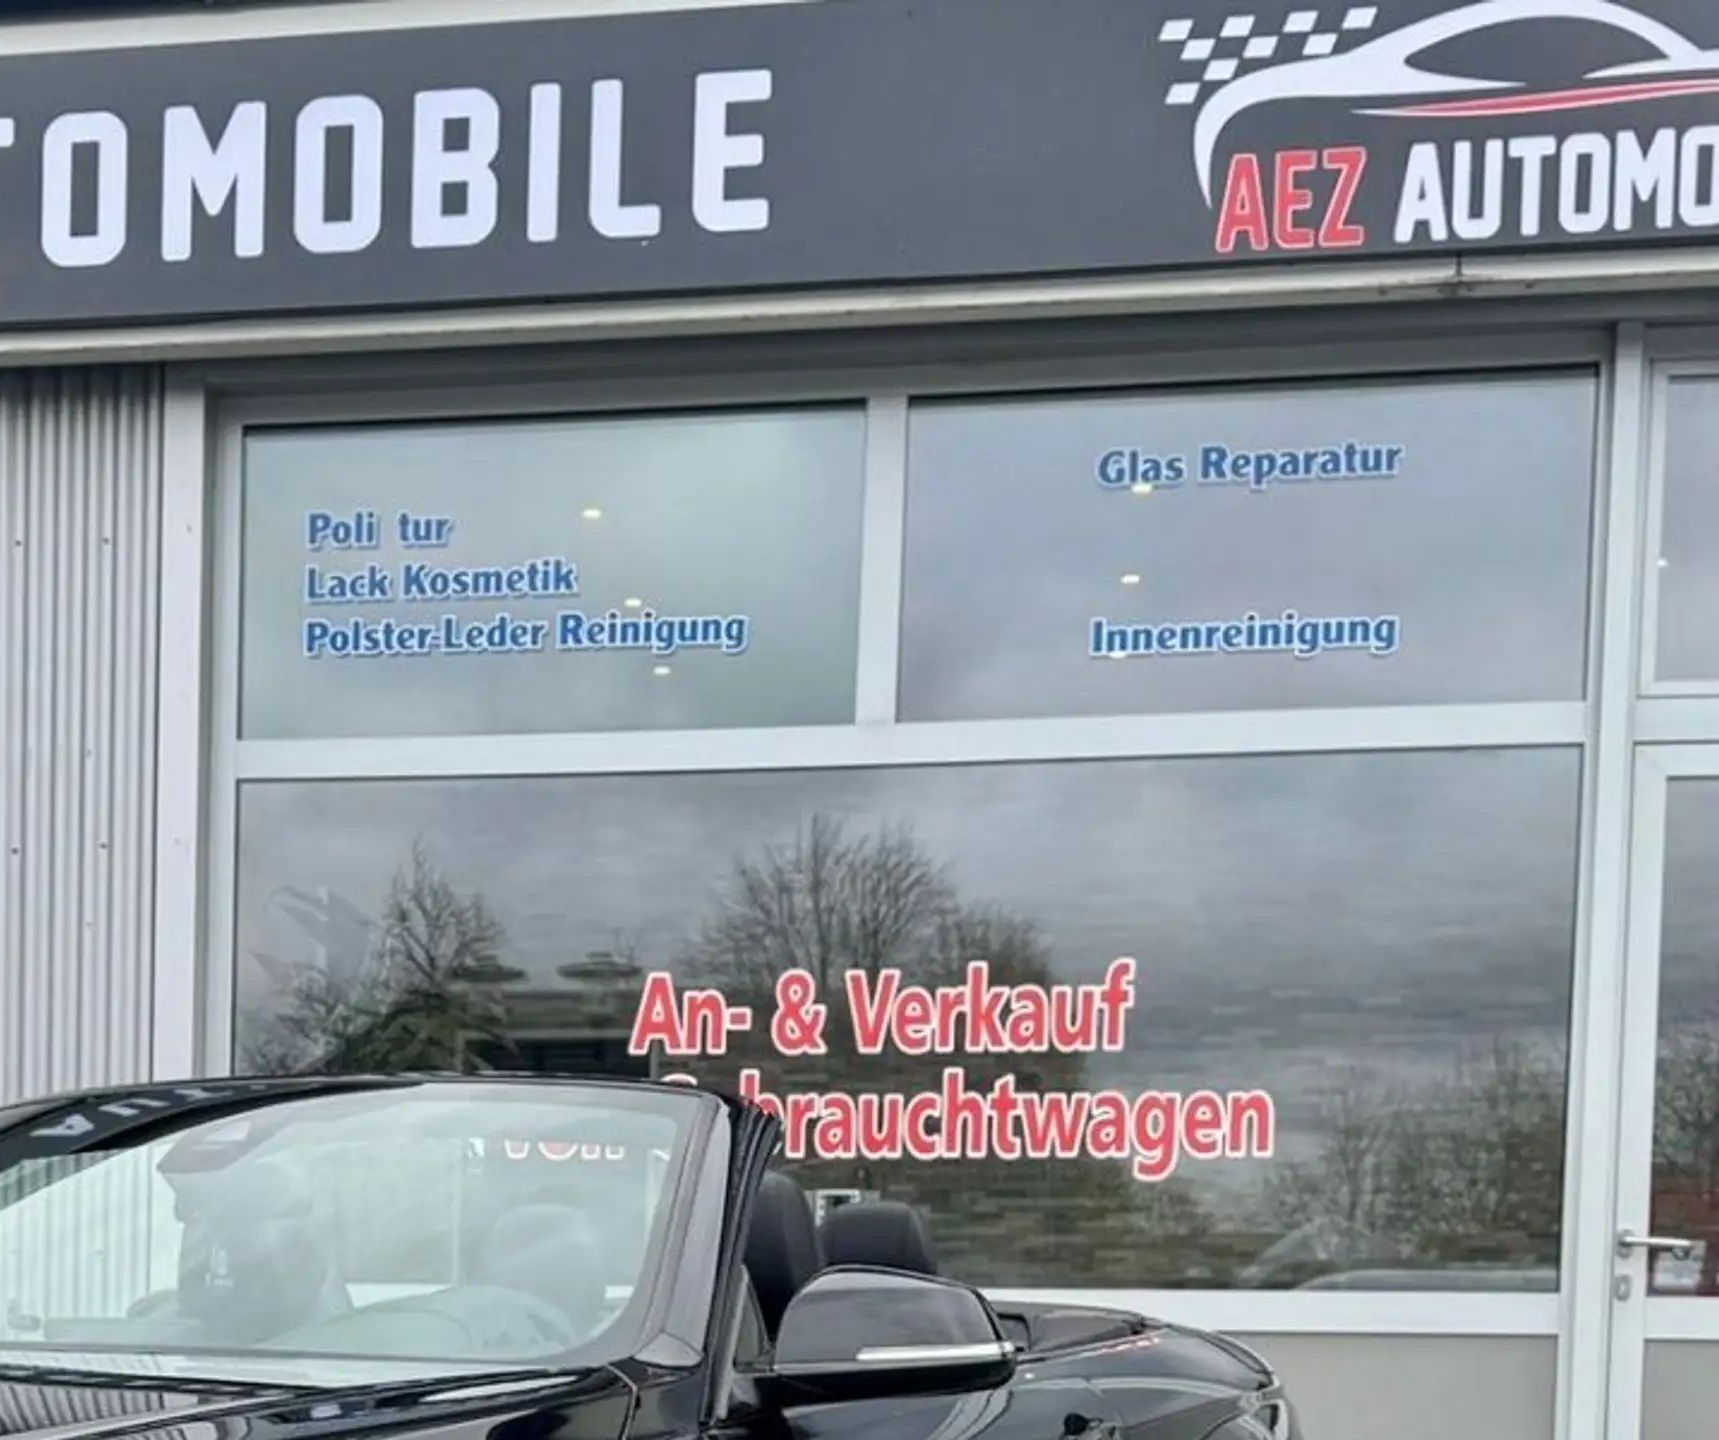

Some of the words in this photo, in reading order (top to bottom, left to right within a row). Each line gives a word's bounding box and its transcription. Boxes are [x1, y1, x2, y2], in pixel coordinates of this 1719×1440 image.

[1215, 146, 1368, 254] AEZ
[1393, 124, 1719, 244] AUTOMO
[1098, 448, 1185, 486] Glas
[1198, 441, 1403, 490] Reparatur
[307, 565, 388, 599] Lack
[401, 557, 579, 597] Kosmetik
[305, 614, 546, 655] Polster-Leder
[556, 609, 749, 653] Reinigung
[1089, 611, 1400, 658] Innenreinigung
[628, 970, 751, 1055] An-
[770, 967, 826, 1053] &
[843, 957, 1136, 1054] Verkauf
